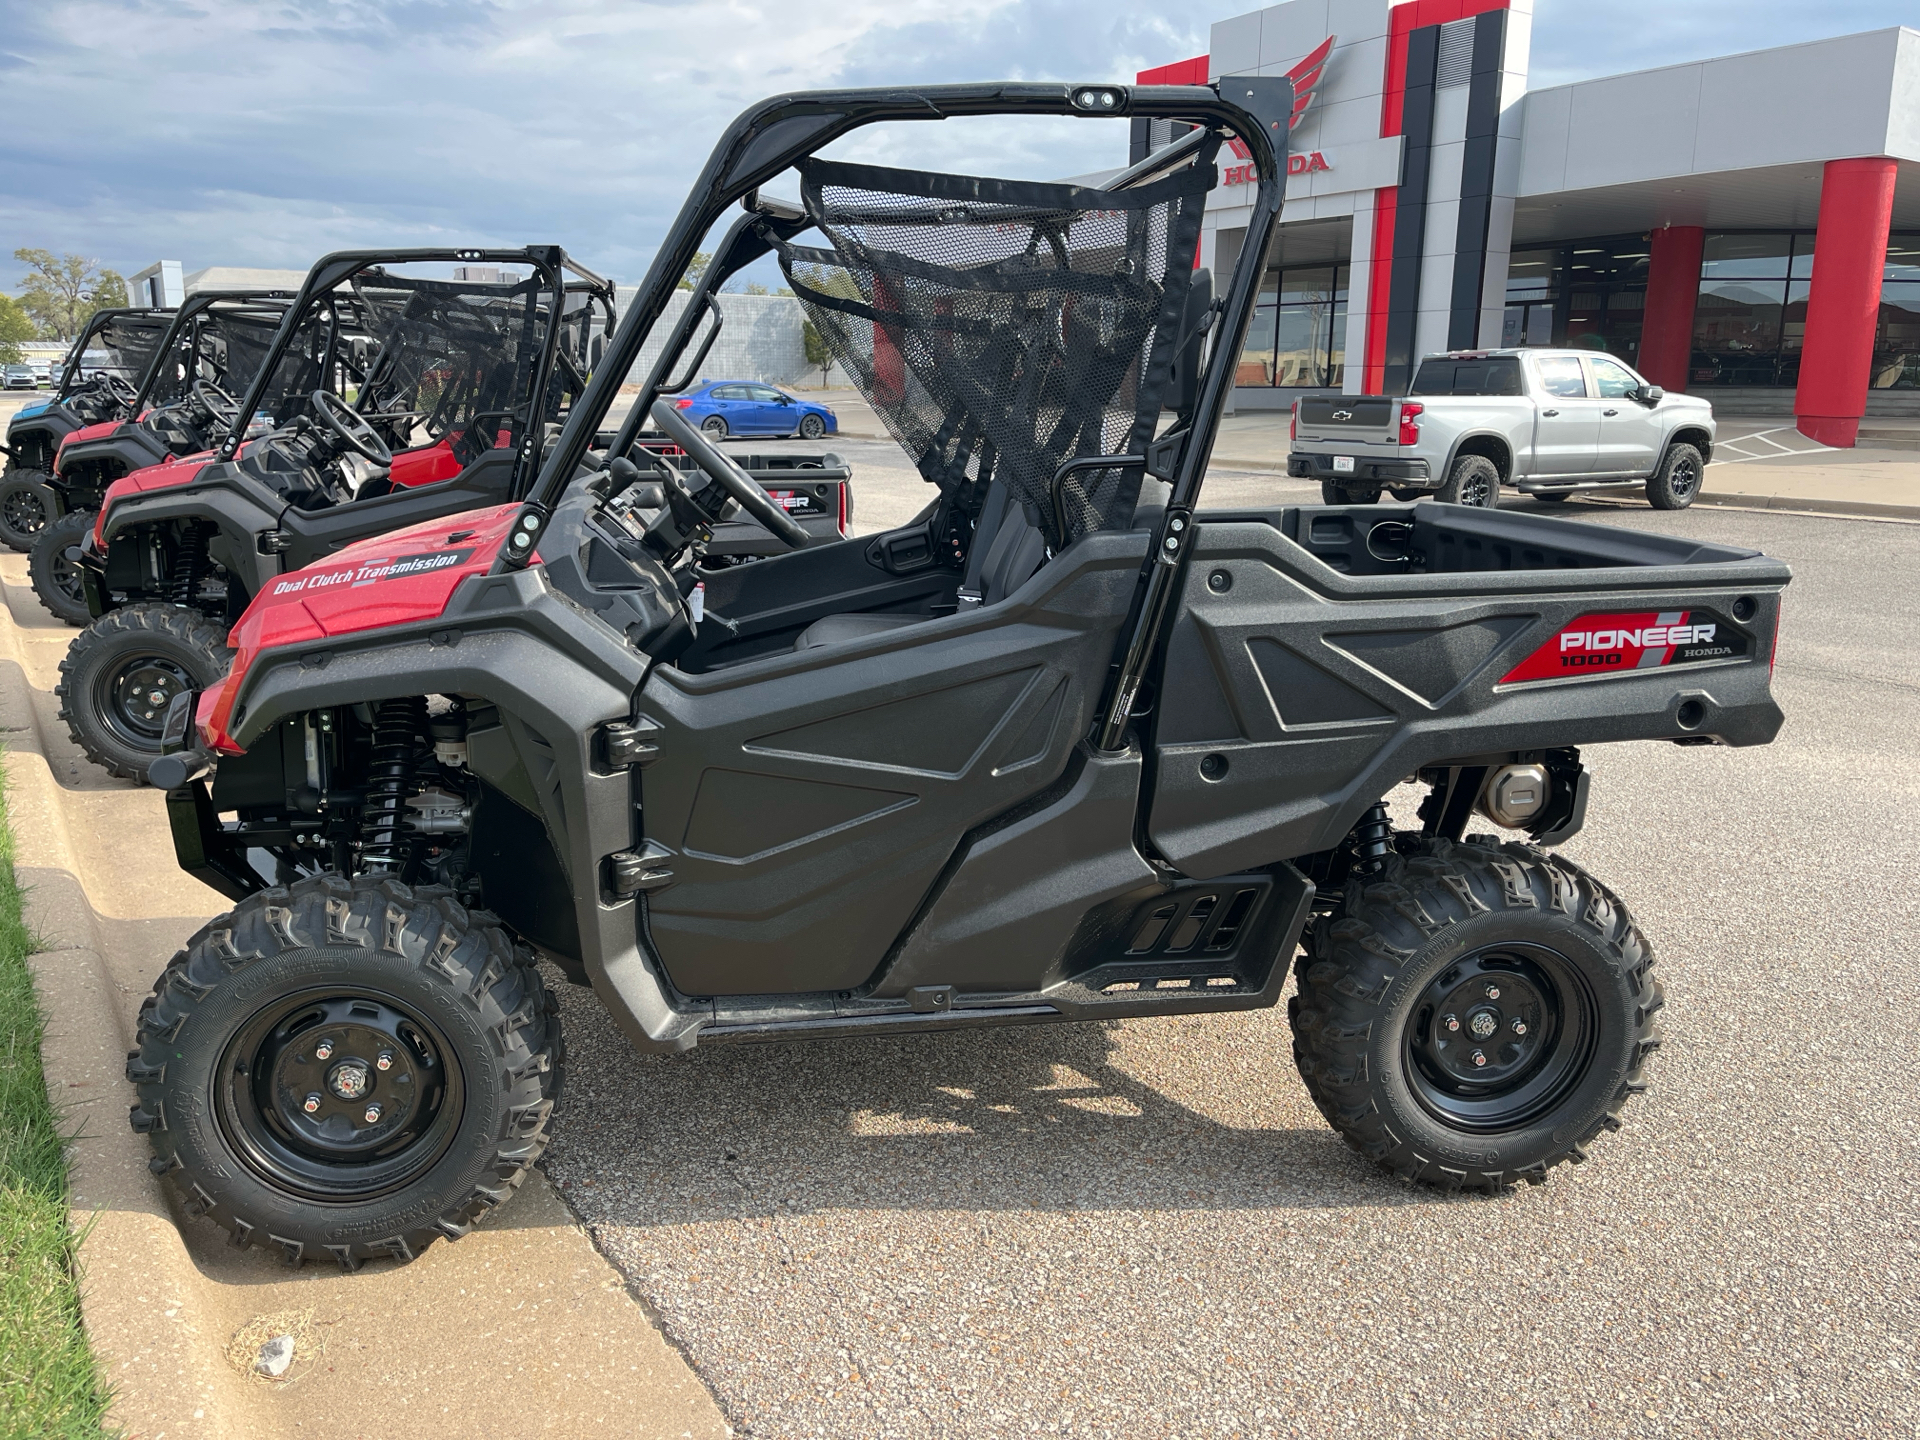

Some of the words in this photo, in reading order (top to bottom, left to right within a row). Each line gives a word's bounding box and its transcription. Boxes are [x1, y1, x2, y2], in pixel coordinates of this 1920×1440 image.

[1223, 151, 1329, 186] HODA
[273, 578, 307, 595] Dual
[307, 569, 352, 588] Clutch
[356, 554, 458, 580] Transmission
[1560, 624, 1716, 651] PIONEER
[1560, 654, 1621, 667] 1000
[1684, 647, 1732, 657] HONDA
